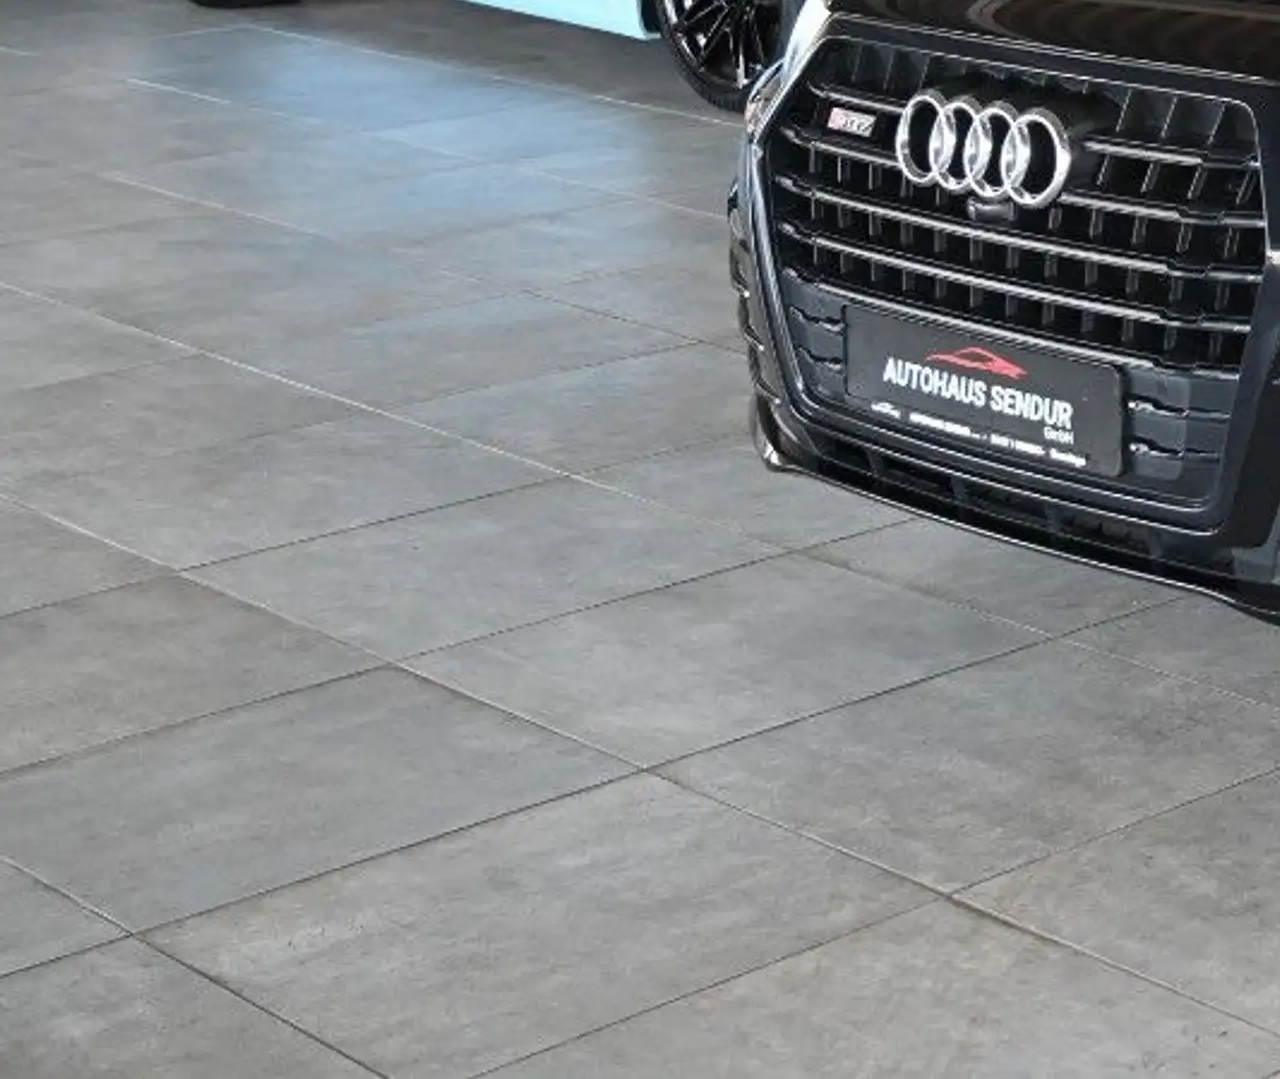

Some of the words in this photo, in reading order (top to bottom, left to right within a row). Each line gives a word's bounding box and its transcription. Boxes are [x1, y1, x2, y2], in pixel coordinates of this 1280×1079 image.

[883, 357, 987, 407] AUTOHAUS
[989, 385, 1074, 429] SENDUR
[1043, 425, 1074, 445] GmbH
